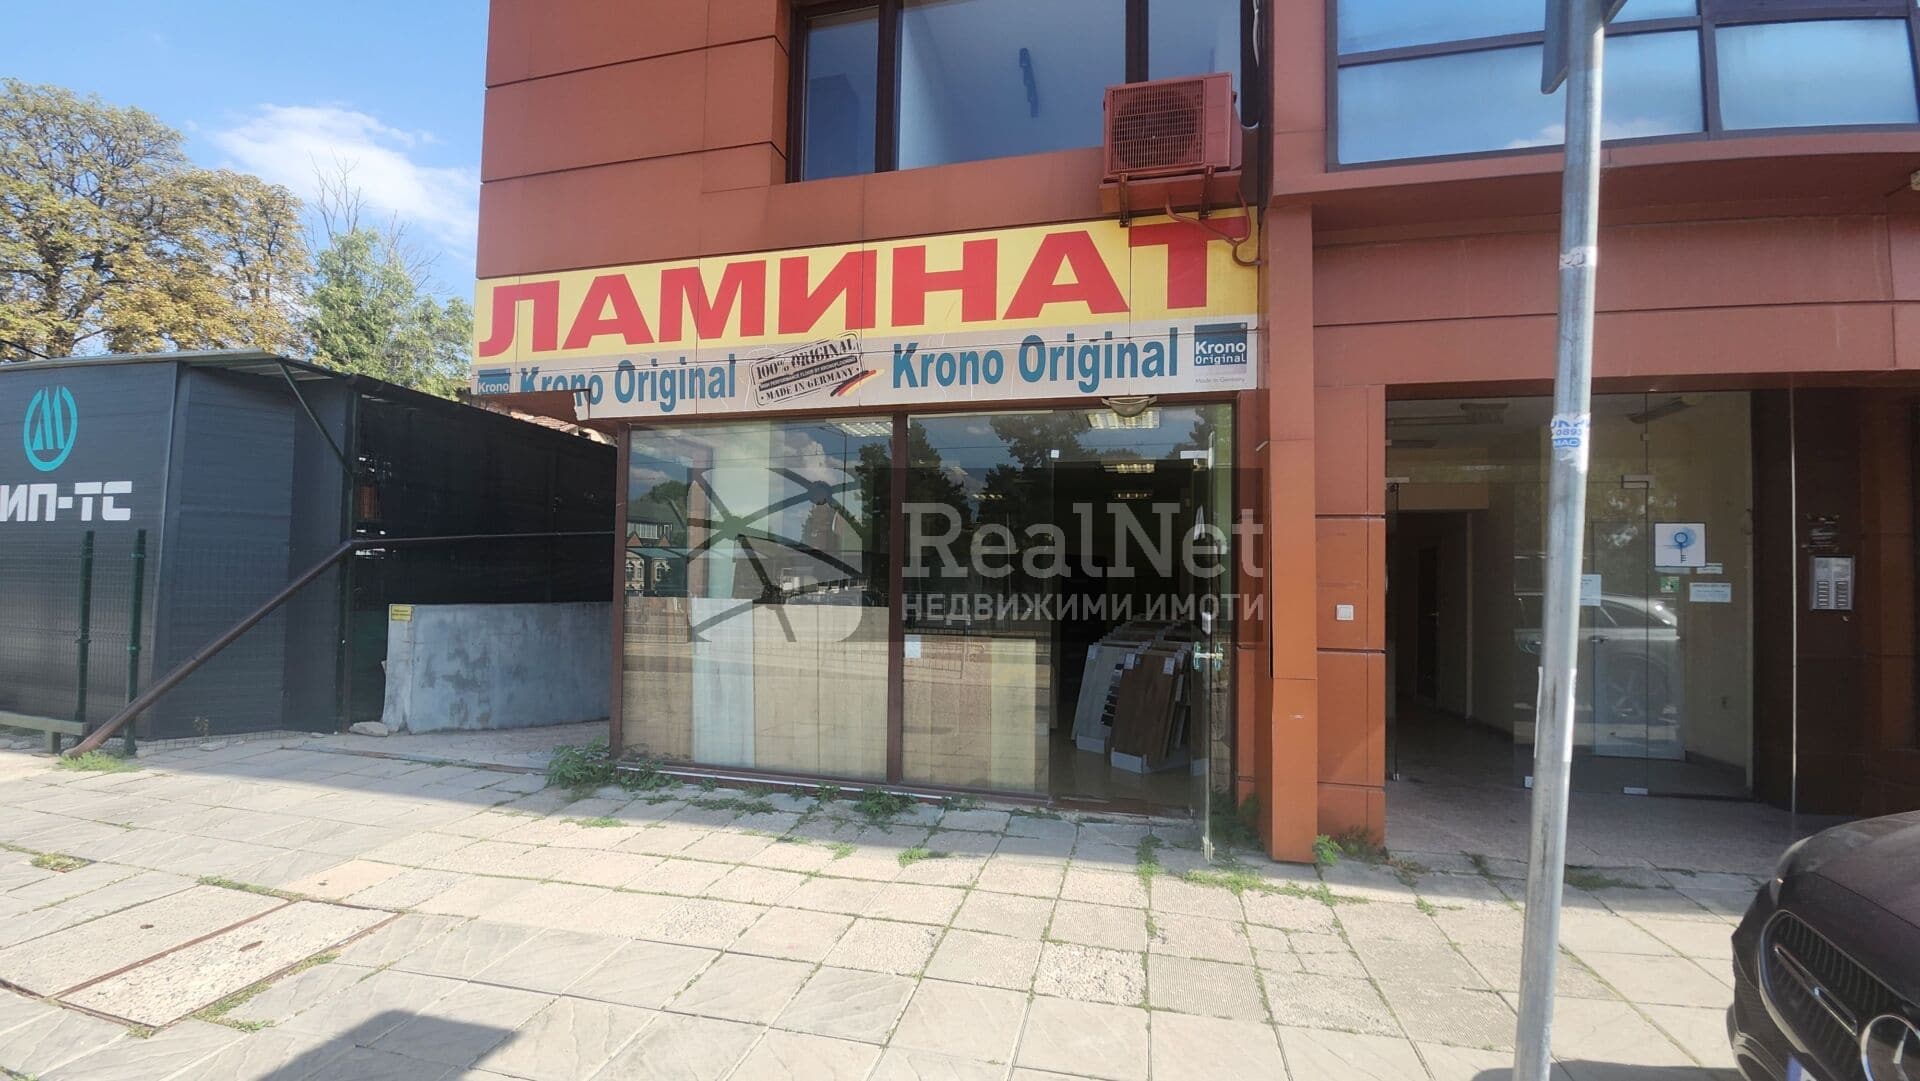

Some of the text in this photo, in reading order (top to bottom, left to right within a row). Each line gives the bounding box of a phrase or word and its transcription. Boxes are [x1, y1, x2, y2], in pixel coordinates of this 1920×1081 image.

[479, 215, 1248, 358] ЛАМИНАТ
[756, 359, 789, 379] 100%
[791, 338, 857, 367] ORIGINAL
[892, 341, 1003, 389] Krono
[1018, 326, 1178, 394] Original
[1195, 340, 1246, 354] Krono
[1195, 352, 1246, 365] Original
[478, 382, 509, 393] Krono
[614, 353, 735, 413] Original
[766, 367, 854, 400] MADE IN GERMANY
